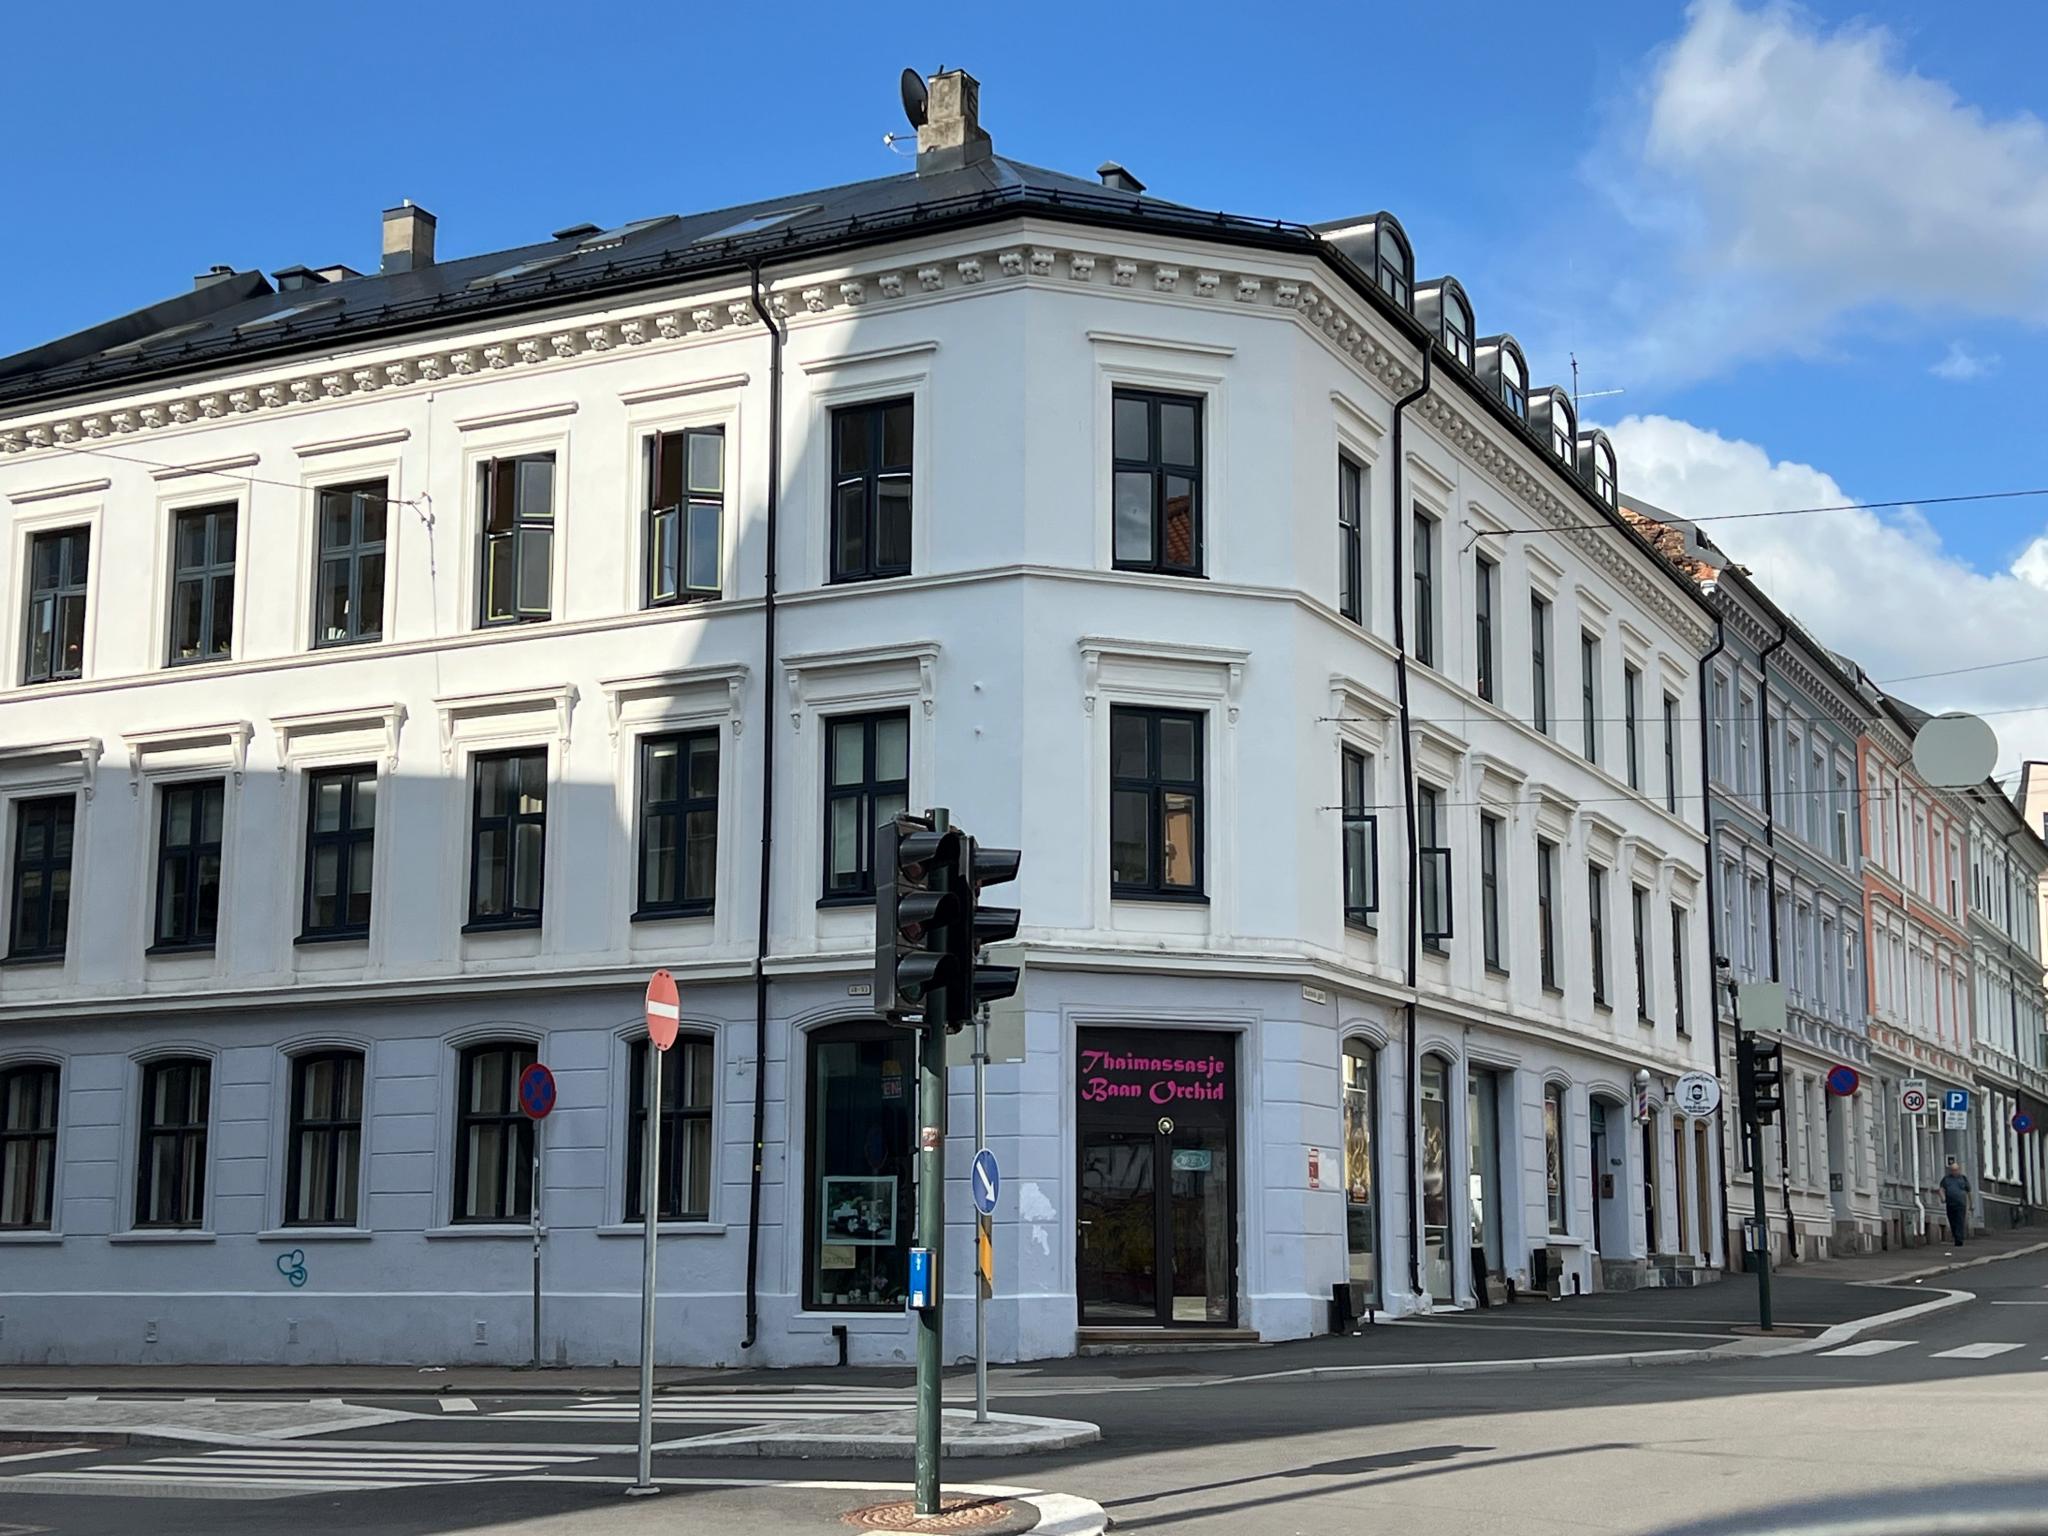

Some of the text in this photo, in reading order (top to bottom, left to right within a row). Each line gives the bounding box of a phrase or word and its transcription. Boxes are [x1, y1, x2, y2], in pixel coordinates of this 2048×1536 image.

[1081, 1050, 1224, 1078] Thaimassasje
[1081, 1077, 1224, 1104] Baan Orchid
[1907, 1095, 1921, 1106] 30
[1950, 1093, 1963, 1108] P
